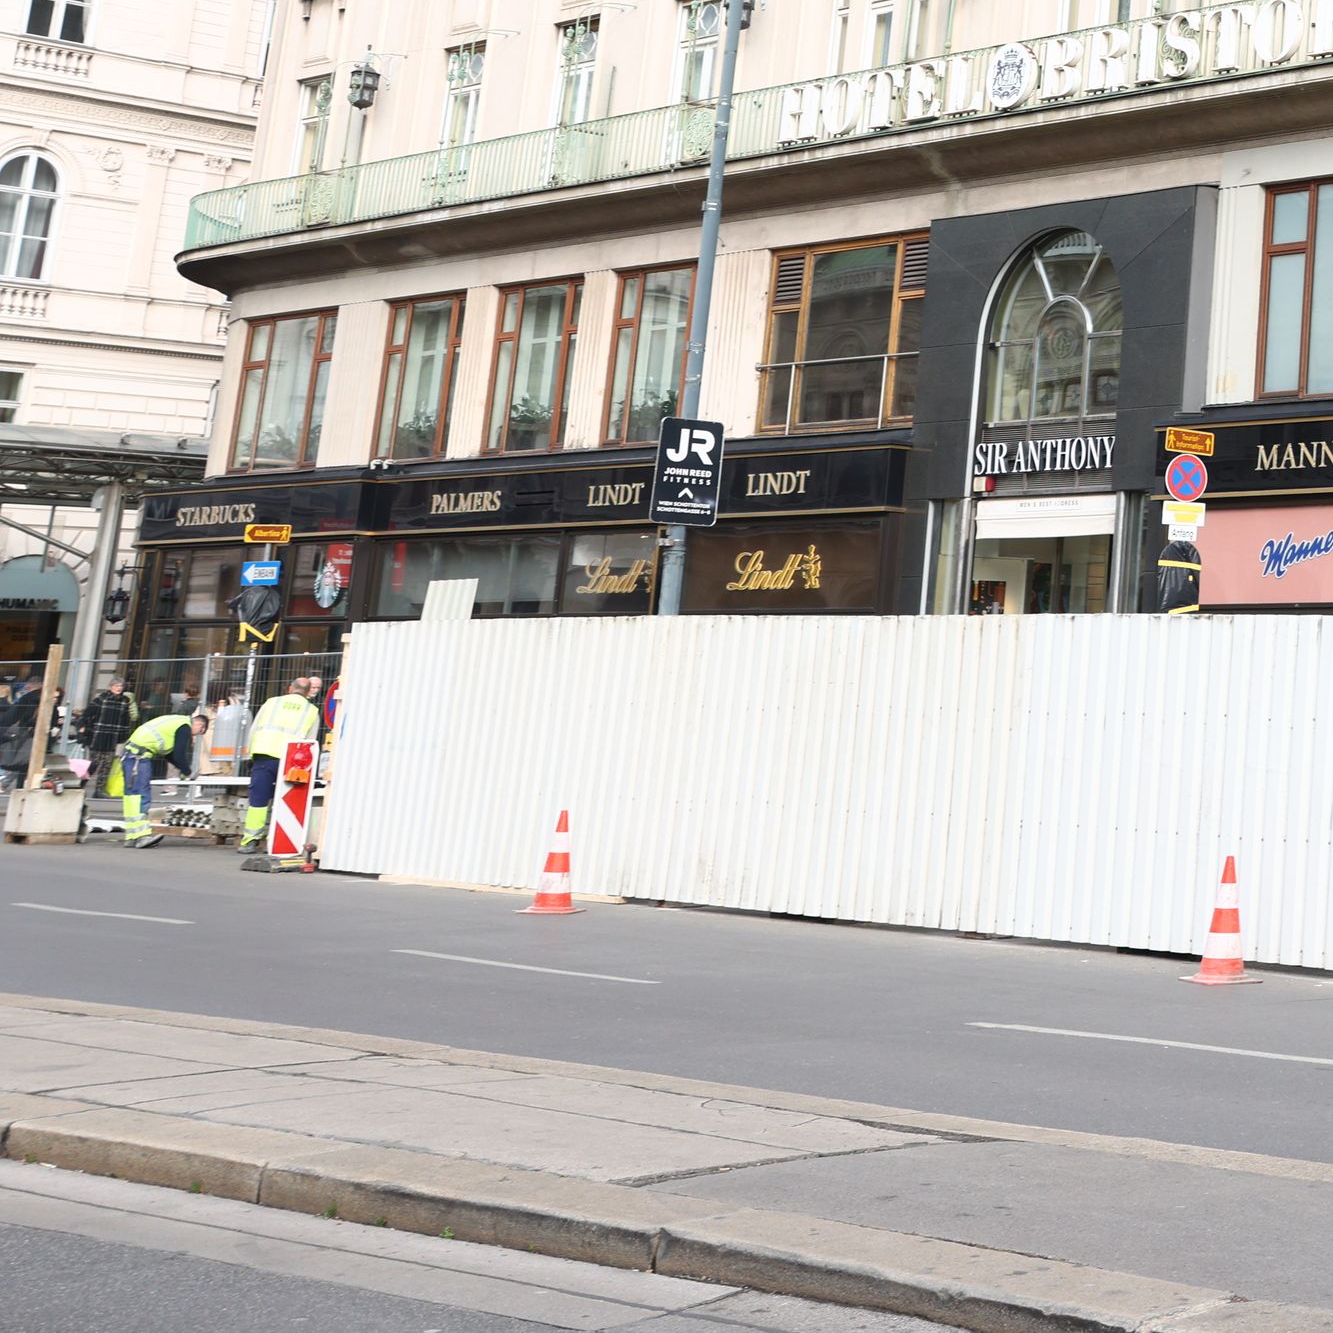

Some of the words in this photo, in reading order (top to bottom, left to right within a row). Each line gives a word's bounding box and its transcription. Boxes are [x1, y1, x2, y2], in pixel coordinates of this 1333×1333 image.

[777, 57, 979, 146] HOTEL
[666, 428, 716, 466] JR
[974, 442, 1008, 475] SIR
[1012, 436, 1116, 472] ANTHONY
[663, 476, 712, 486] FITNESS
[664, 467, 689, 476] JOHN
[689, 468, 713, 478] REED
[746, 470, 810, 497] LINDT
[430, 490, 502, 515] PALMERS
[587, 482, 646, 507] LINDT
[176, 503, 256, 526] STARBUCKS
[1172, 528, 1195, 541] Anfang
[576, 556, 646, 594] Lindt
[726, 550, 802, 592] Lindt
